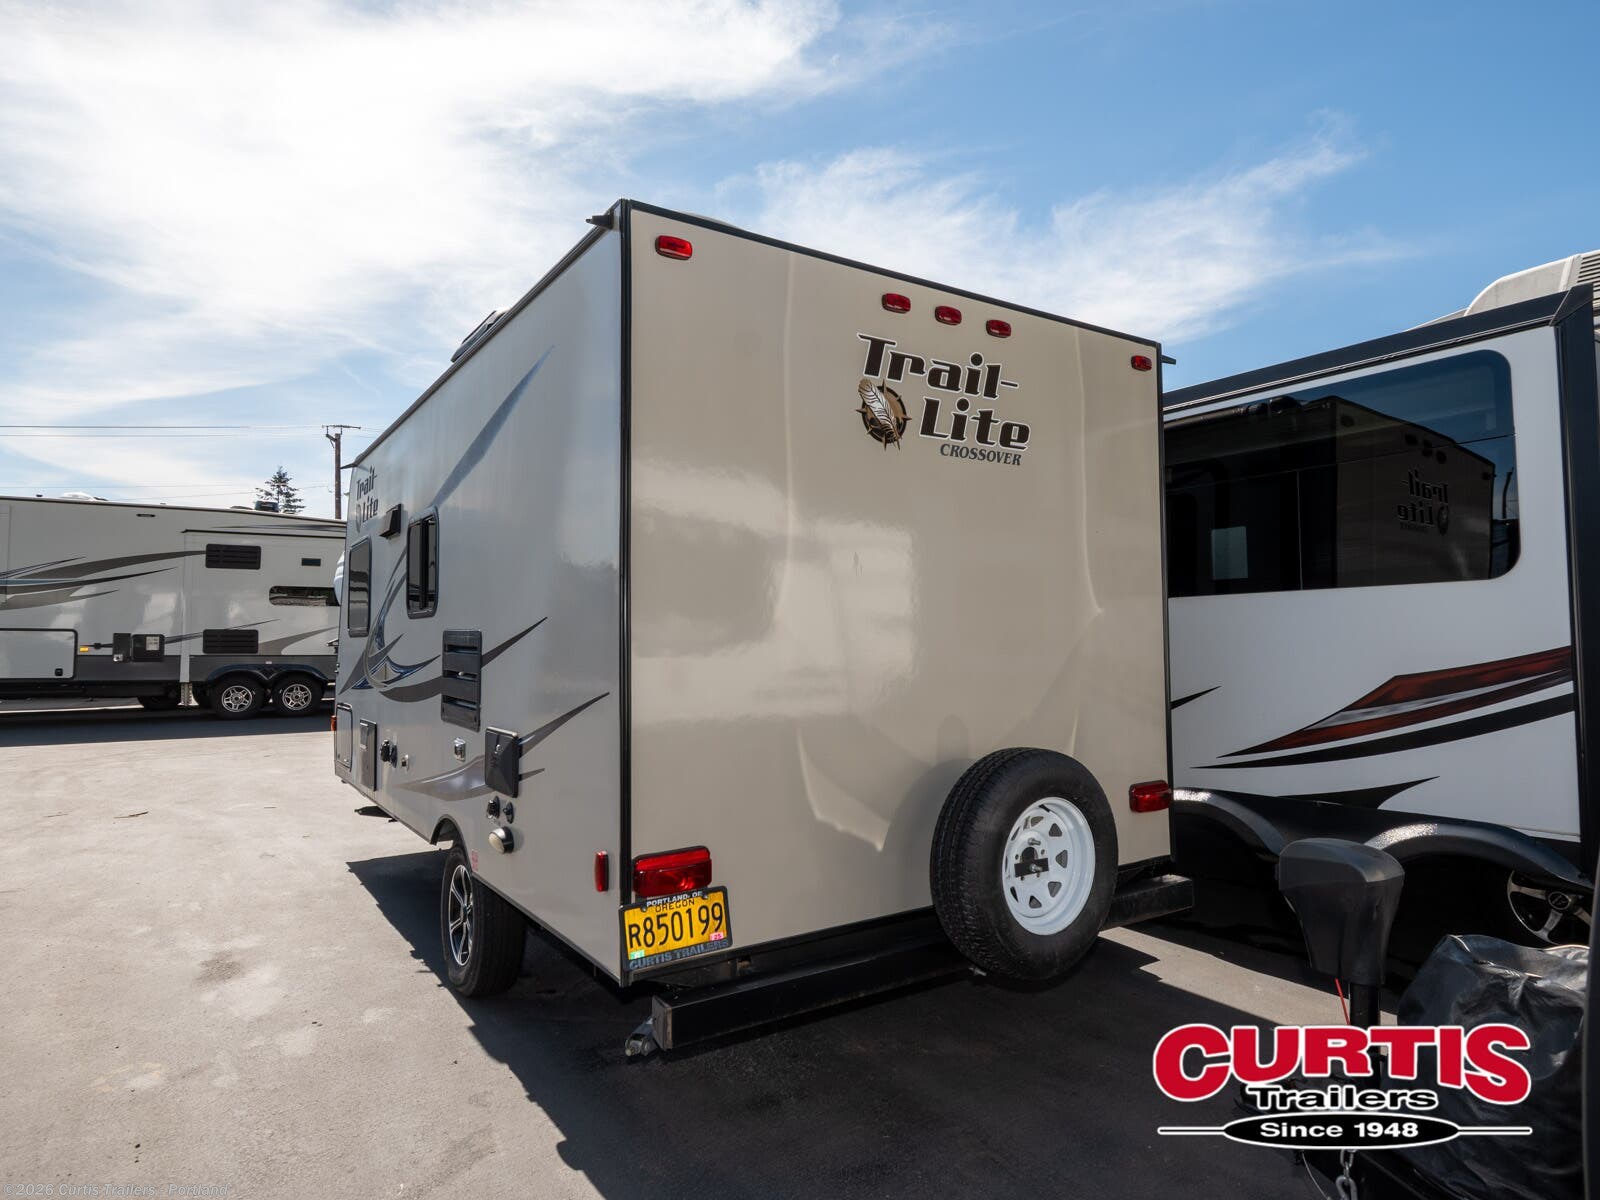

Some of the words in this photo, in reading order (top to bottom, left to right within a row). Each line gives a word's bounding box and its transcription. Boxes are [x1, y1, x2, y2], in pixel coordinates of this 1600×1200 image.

[857, 333, 1018, 399] Trail-
[919, 397, 1030, 450] Lite
[939, 443, 1022, 466] CROSSOVER
[362, 495, 379, 523] Lite
[655, 899, 694, 912] OREGON
[628, 902, 722, 948] R850199
[630, 952, 672, 969] CURTIS
[676, 941, 728, 958] TRAILERS
